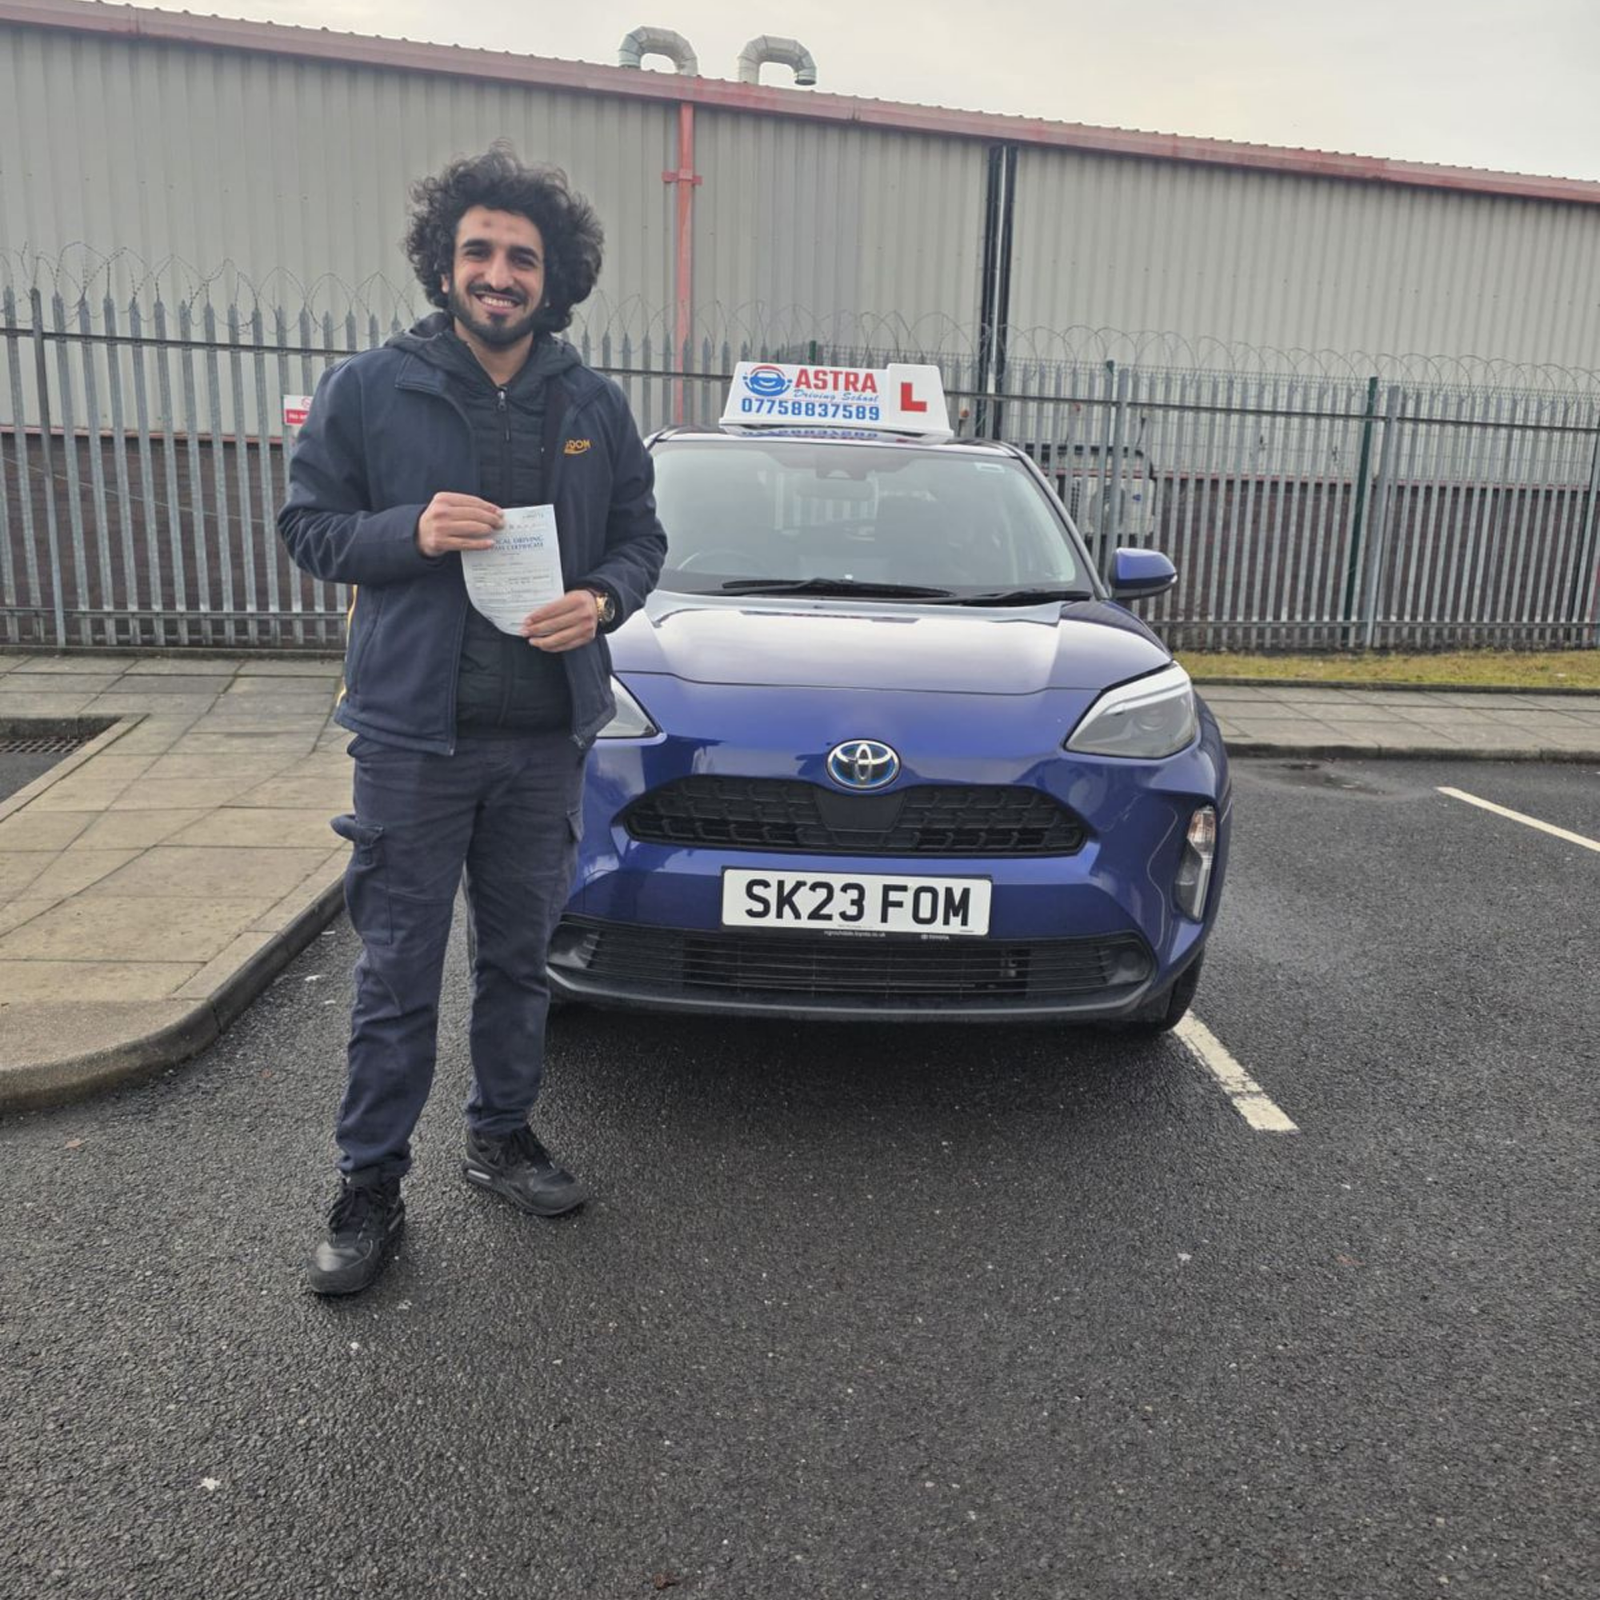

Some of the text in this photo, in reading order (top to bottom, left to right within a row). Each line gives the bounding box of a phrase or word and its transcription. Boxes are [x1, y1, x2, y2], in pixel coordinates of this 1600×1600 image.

[795, 368, 877, 393] ASTRA
[793, 388, 879, 402] Driving School
[900, 382, 927, 412] L
[741, 398, 880, 421] 07758837589
[745, 879, 971, 927] SK23 FOM
